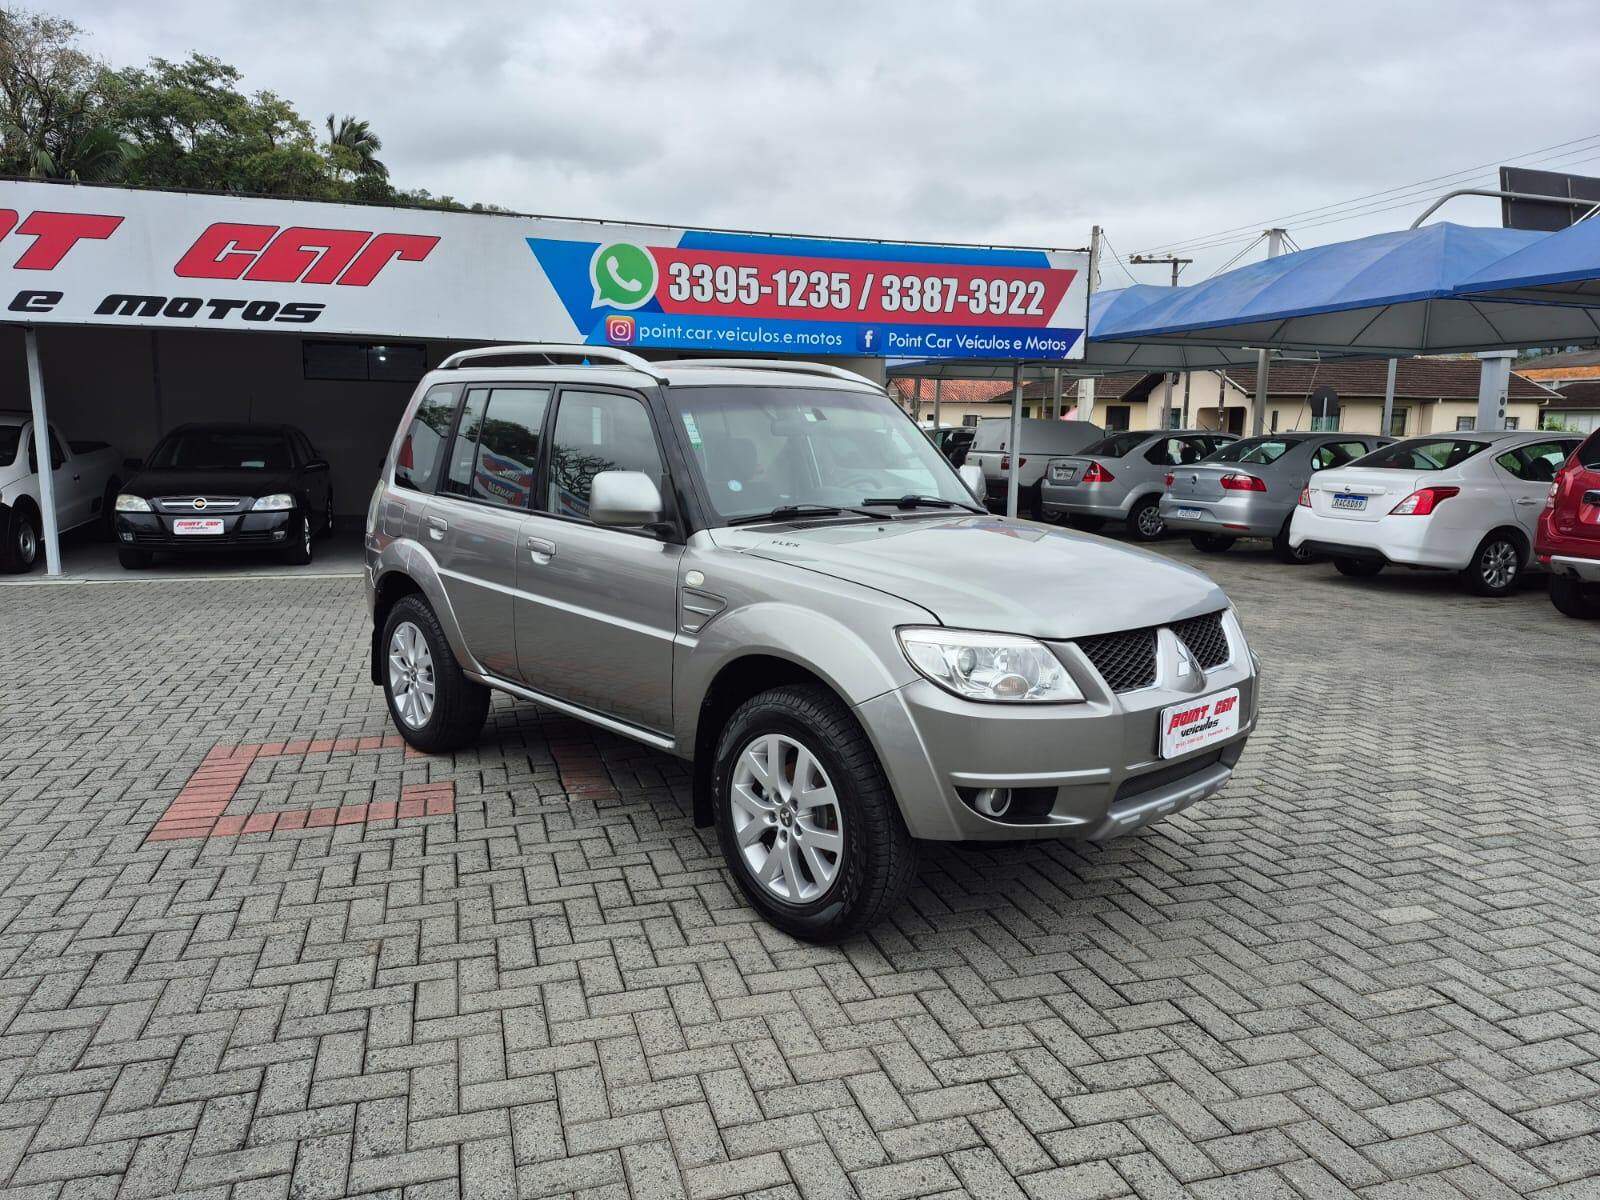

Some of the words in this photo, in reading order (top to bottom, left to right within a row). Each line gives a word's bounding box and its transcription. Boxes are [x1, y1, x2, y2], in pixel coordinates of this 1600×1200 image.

[0, 208, 125, 271] T
[668, 262, 850, 310] 3395-1235
[857, 273, 874, 311] /
[881, 274, 1046, 315] 3387-3922
[639, 324, 842, 346] point.car.veiculos.e.motos
[889, 332, 922, 348] Point
[925, 333, 952, 349] Car
[955, 334, 1009, 350] Veículos
[1013, 339, 1021, 350] e
[1025, 336, 1066, 351] Motos
